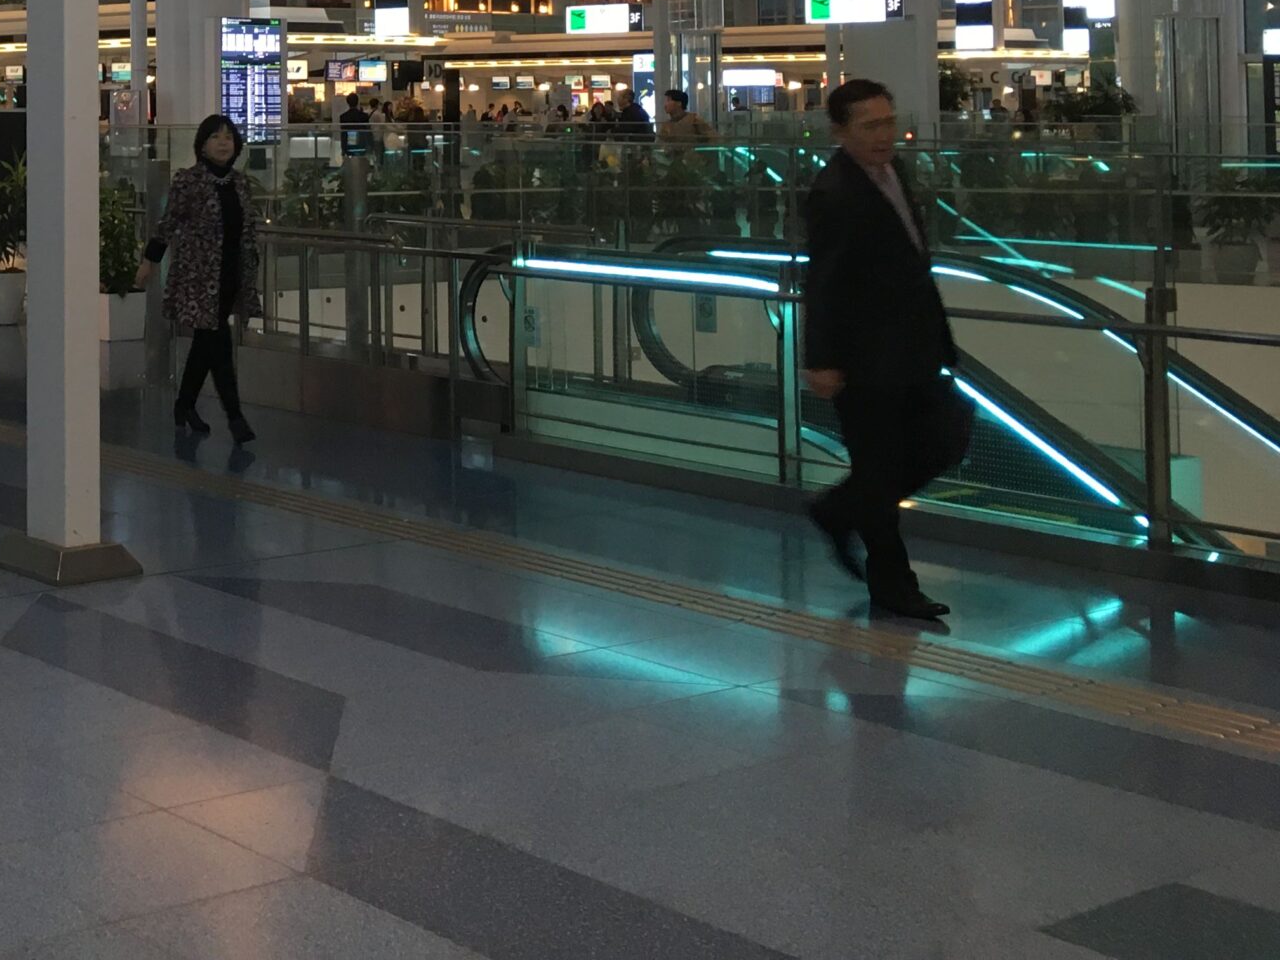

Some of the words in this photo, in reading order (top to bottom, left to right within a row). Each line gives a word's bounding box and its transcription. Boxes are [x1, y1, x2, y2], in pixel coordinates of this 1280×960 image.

[630, 12, 641, 24] 3F
[434, 63, 442, 78] D
[990, 71, 999, 83] C
